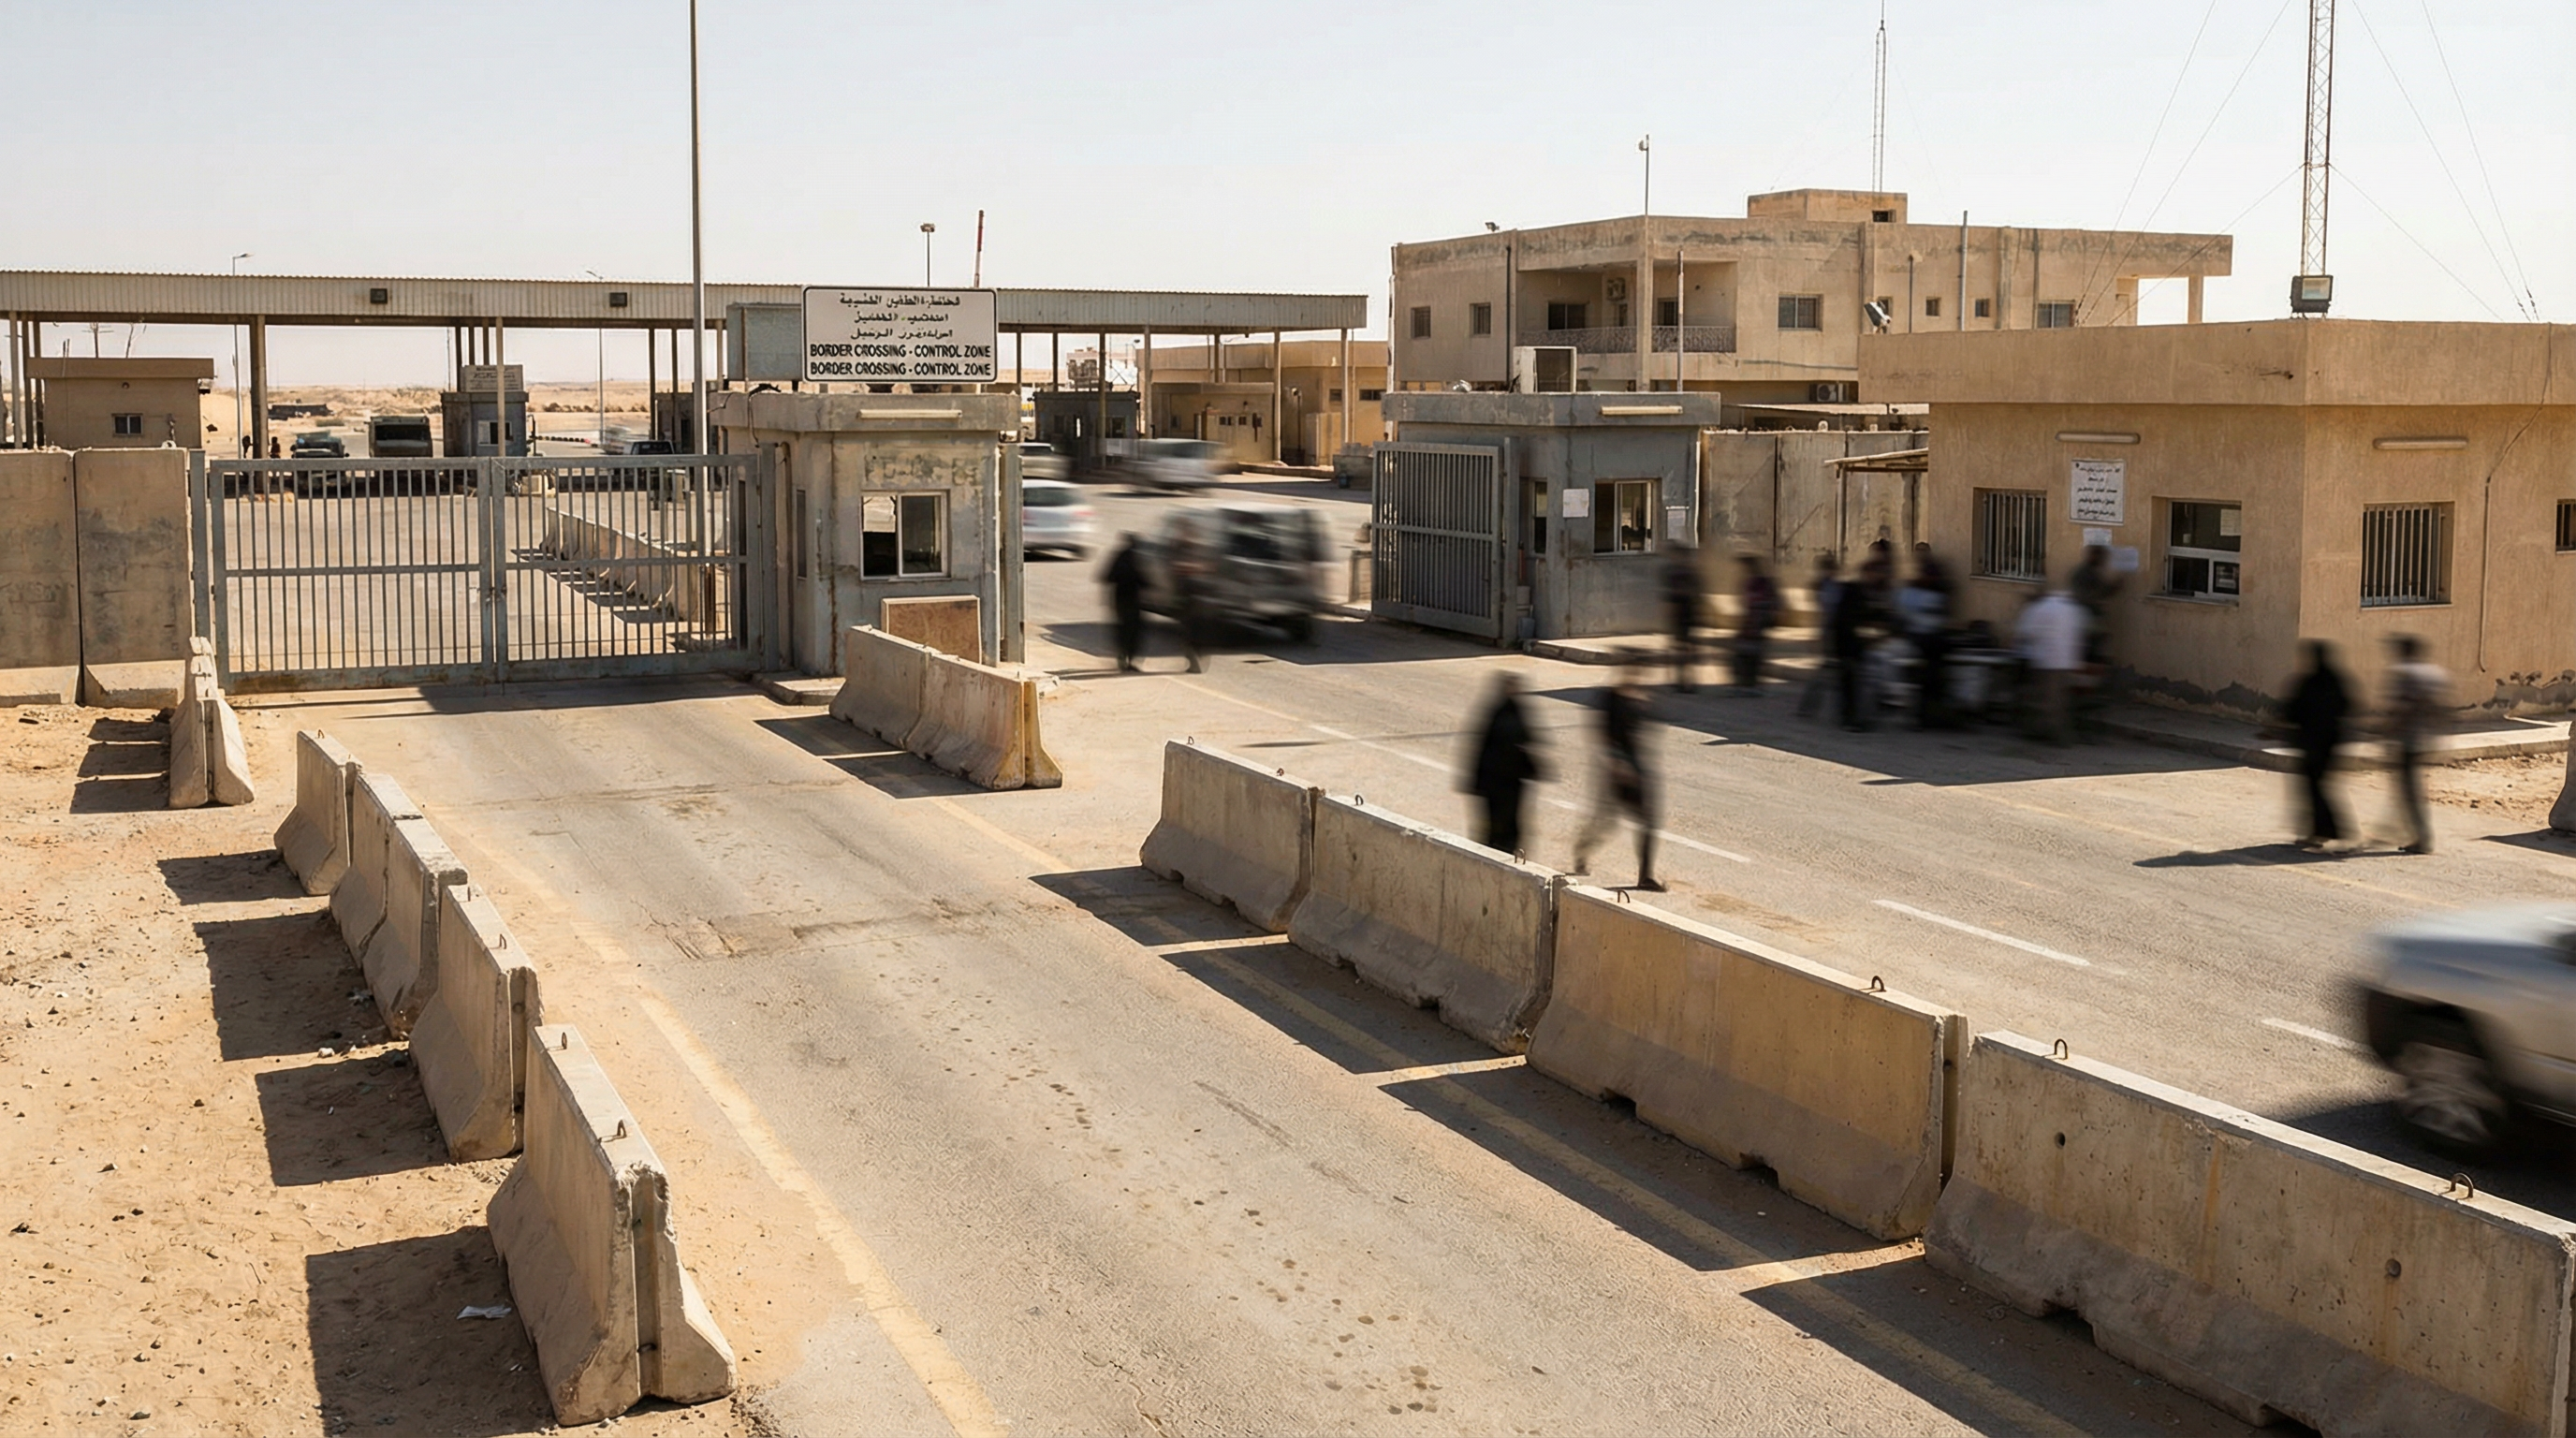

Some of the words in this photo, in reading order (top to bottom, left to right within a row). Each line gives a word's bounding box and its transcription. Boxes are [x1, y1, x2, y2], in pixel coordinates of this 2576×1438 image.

[810, 344, 853, 357] BORDER
[854, 344, 906, 358] CROSSING
[915, 344, 962, 358] CONTROL
[964, 345, 990, 358] ZONE
[811, 361, 853, 375] BORDER
[855, 361, 906, 375] CROSSING
[914, 362, 962, 375] CONTROL
[964, 362, 990, 375] ZONE
